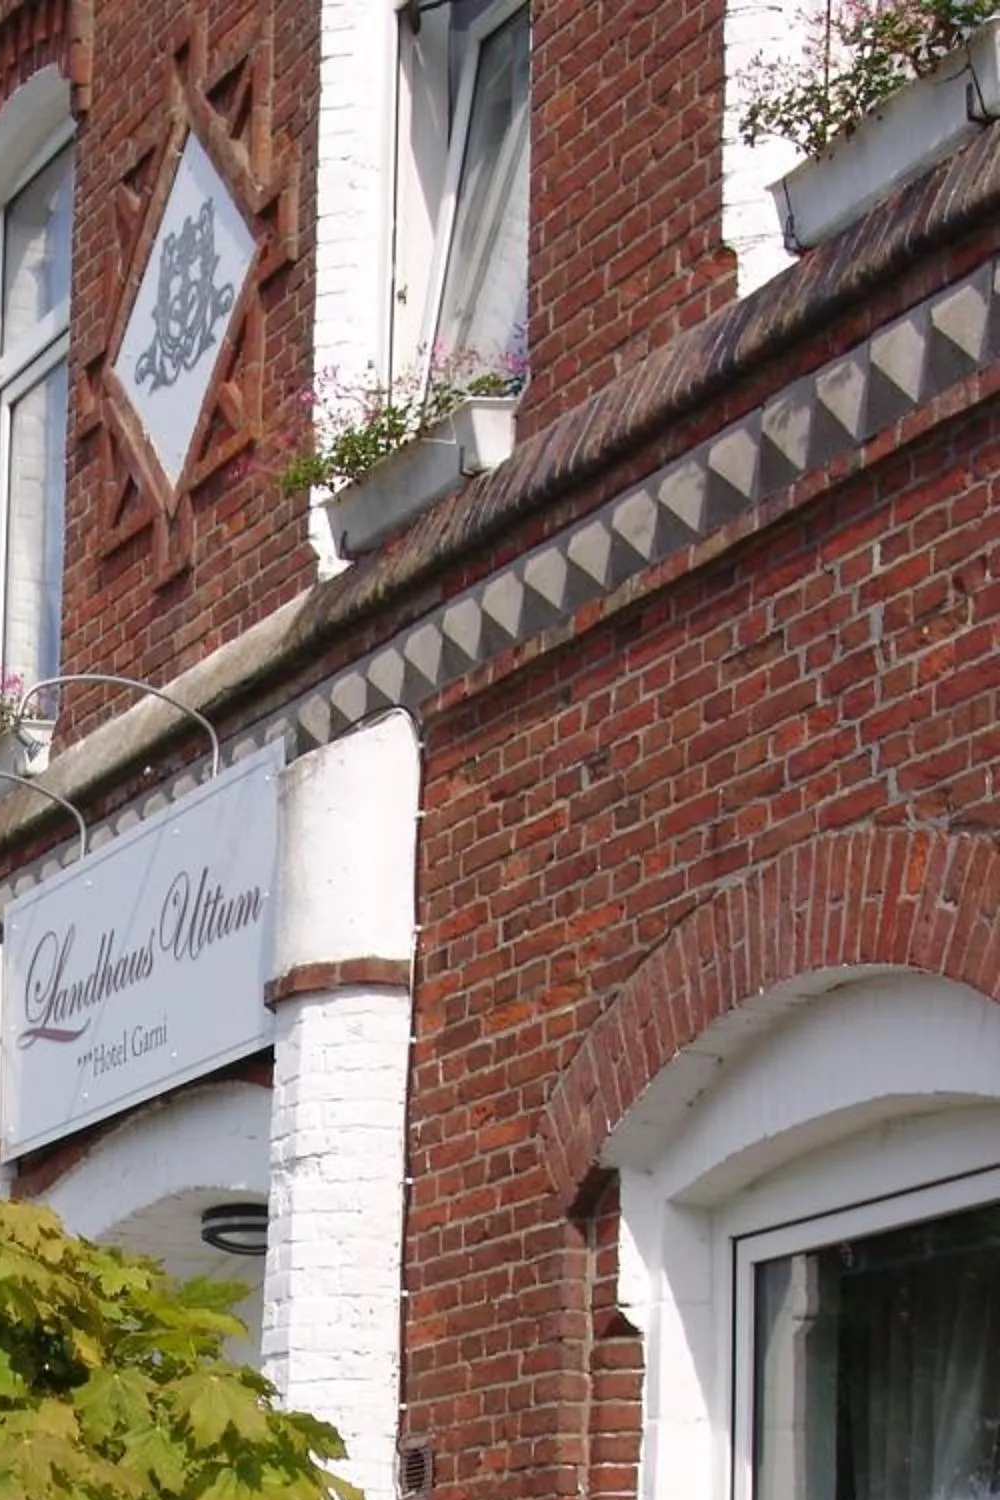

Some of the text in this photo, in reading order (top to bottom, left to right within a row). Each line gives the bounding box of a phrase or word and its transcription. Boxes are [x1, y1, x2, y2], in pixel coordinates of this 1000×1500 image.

[18, 866, 263, 1048] Landhaus Uttum
[131, 1014, 168, 1057] Garni
